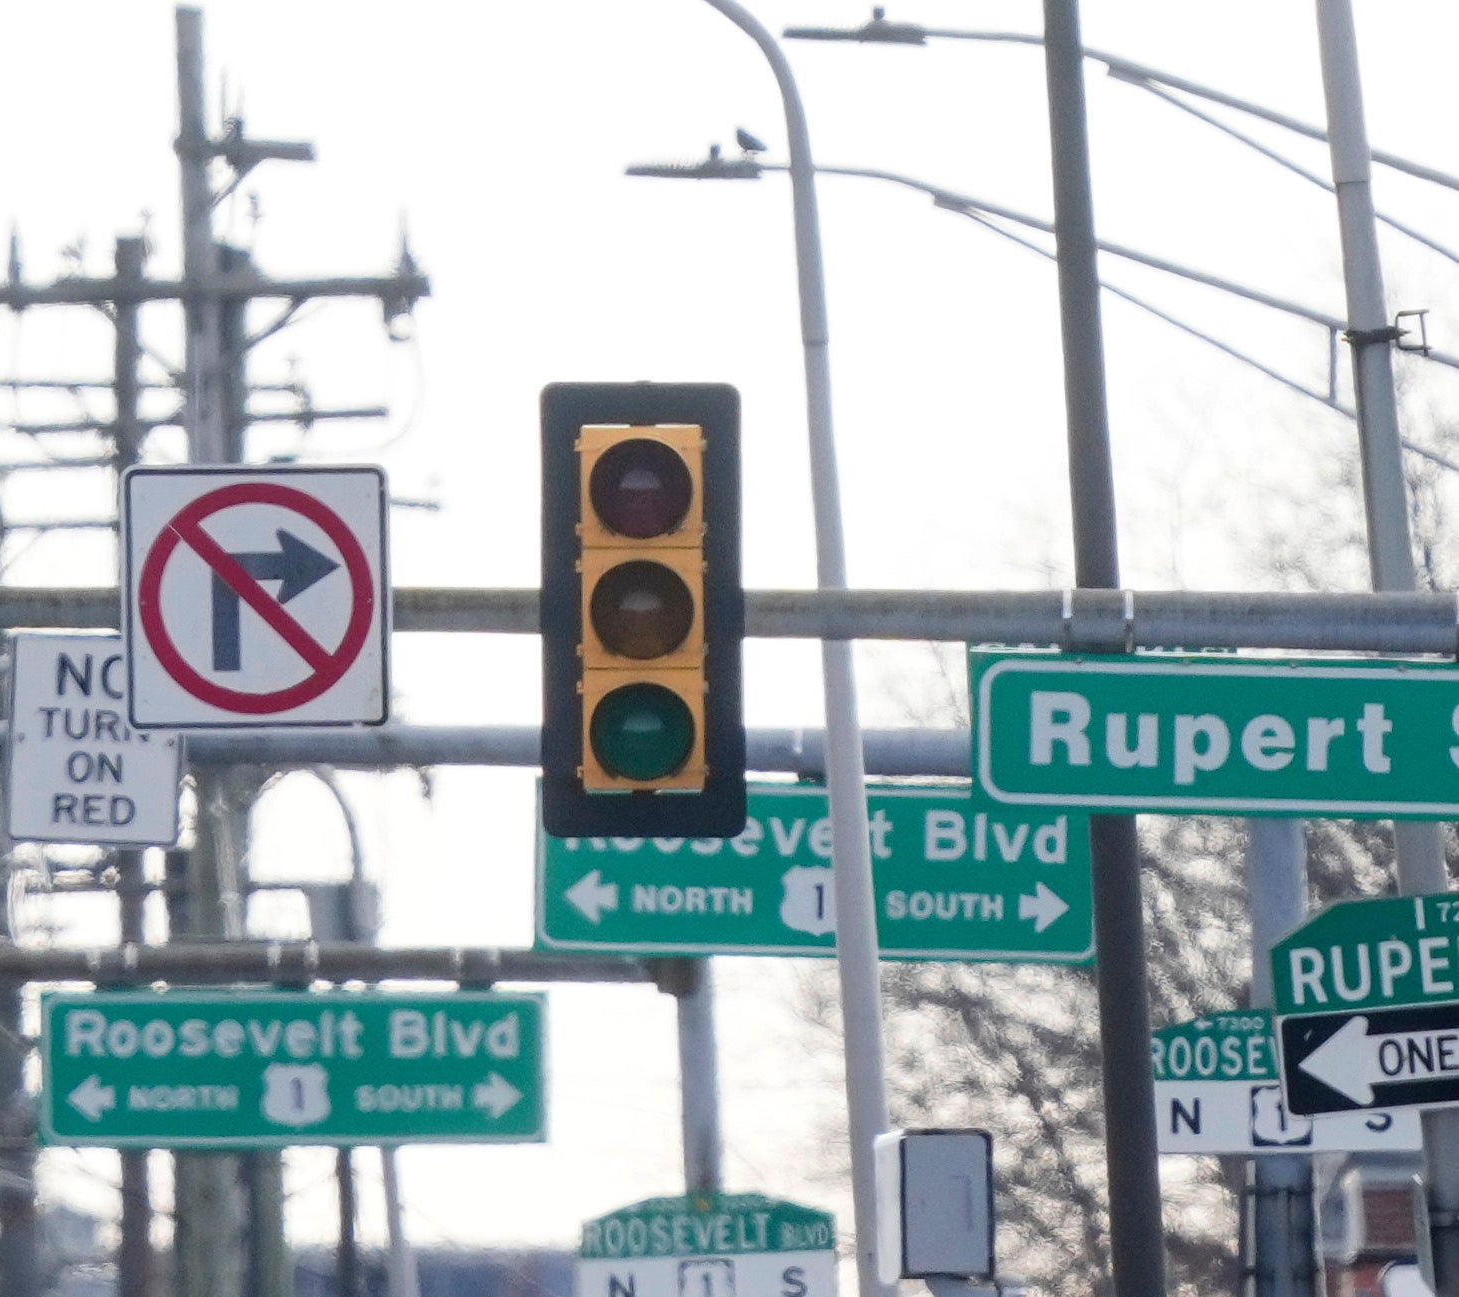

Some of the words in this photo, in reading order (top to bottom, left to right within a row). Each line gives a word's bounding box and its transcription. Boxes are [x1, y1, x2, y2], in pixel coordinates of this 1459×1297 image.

[1029, 690, 1393, 785] Rupert
[67, 752, 122, 783] ON
[52, 794, 136, 826] RED
[926, 810, 1067, 863] Blvd
[632, 884, 753, 915] NORTH
[885, 890, 1004, 920] SOUTH
[1290, 936, 1459, 1004] RUPE
[65, 1009, 364, 1059] Roosevelt
[388, 1010, 519, 1059] Blvd
[1217, 1016, 1265, 1031] 7300
[1379, 1034, 1459, 1076] ONE
[127, 1085, 239, 1111] NORTH
[291, 1076, 305, 1113] 1
[354, 1085, 462, 1111] SOUTH
[1171, 1097, 1202, 1135] N
[1274, 1102, 1287, 1132] 1
[582, 1213, 771, 1252] ROOSEVELT
